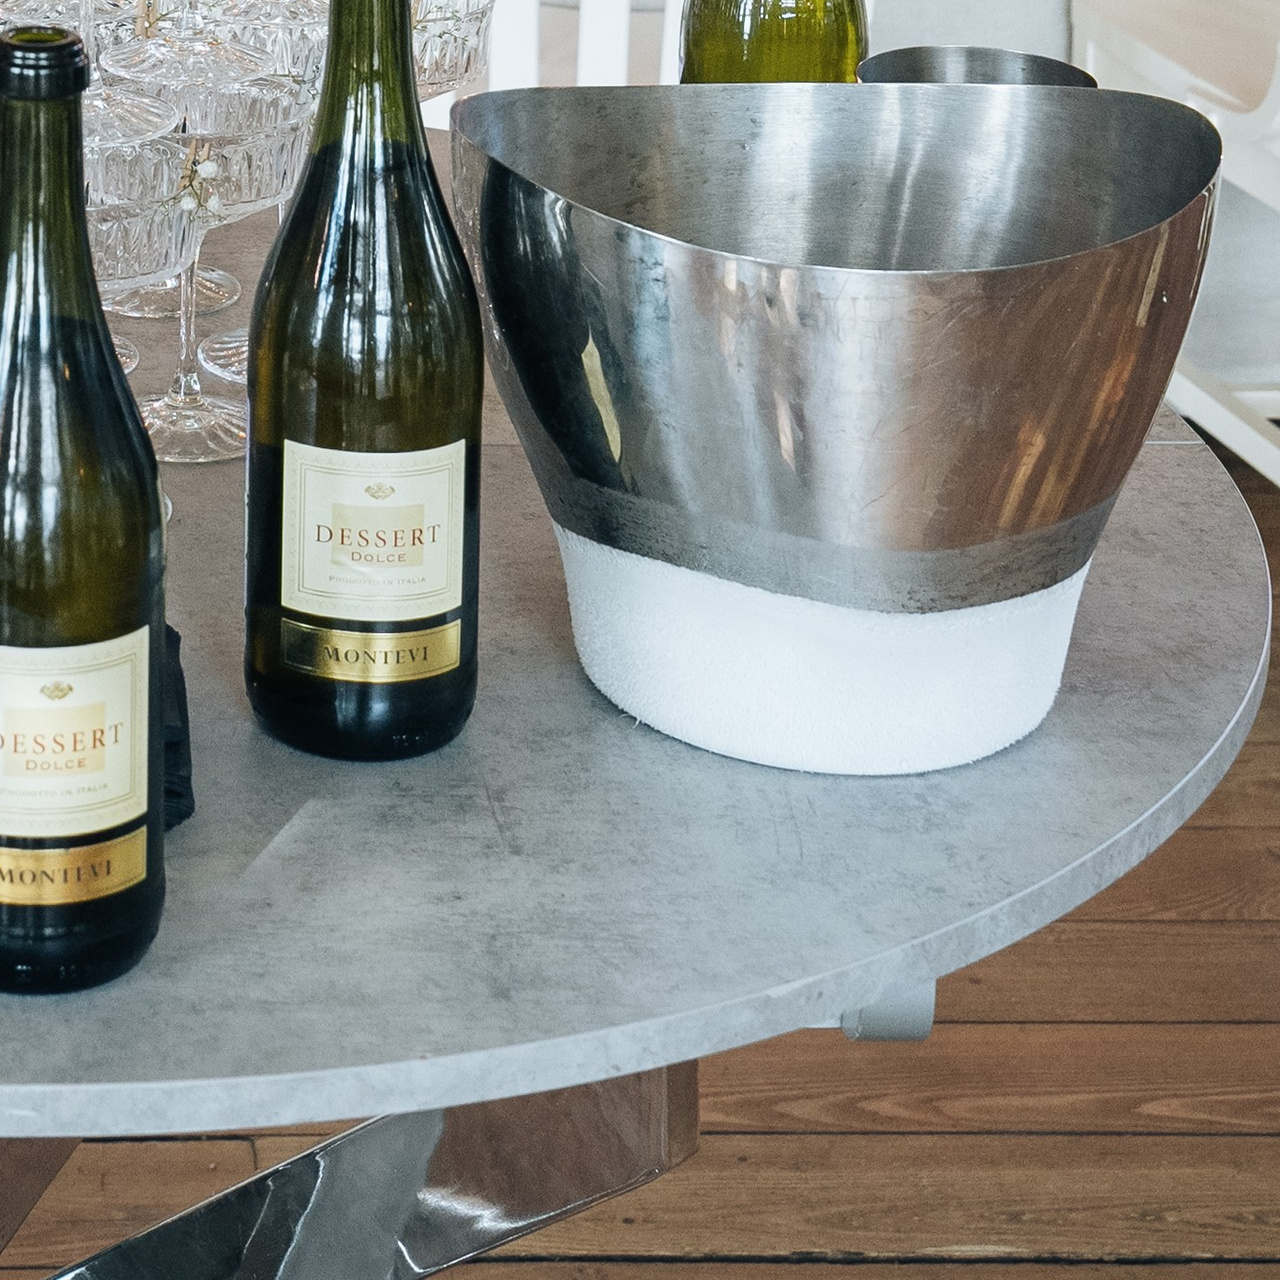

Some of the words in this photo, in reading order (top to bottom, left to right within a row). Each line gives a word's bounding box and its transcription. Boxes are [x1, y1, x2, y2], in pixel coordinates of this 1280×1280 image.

[316, 524, 441, 548] DESSERT
[351, 551, 407, 563] DOLCE
[397, 576, 427, 586] ITALIA
[322, 645, 429, 664] MONTEVI
[26, 757, 86, 771] DOLCE
